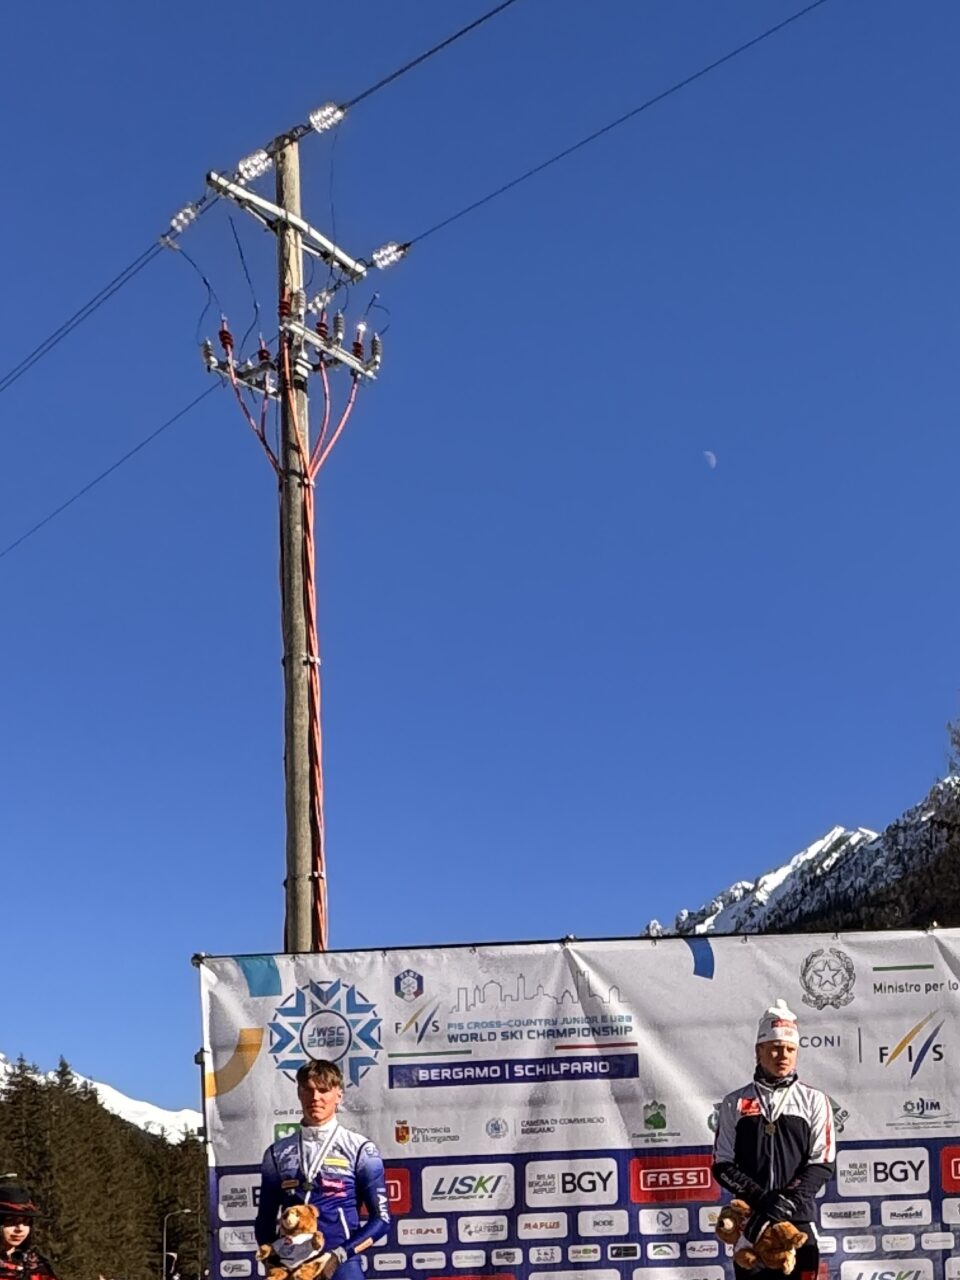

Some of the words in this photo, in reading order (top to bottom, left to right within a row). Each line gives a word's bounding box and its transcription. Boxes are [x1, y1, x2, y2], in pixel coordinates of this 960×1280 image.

[873, 982, 921, 995] Ministro
[925, 983, 943, 995] per
[947, 981, 959, 992] lo
[307, 1026, 345, 1038] JWSC
[447, 1022, 465, 1032] FIS
[466, 1018, 558, 1031] CROSS-COUNTRY
[447, 1031, 497, 1043] WORLD
[501, 1029, 523, 1041] SKI
[527, 1025, 633, 1040] CHAMPIONSHIP
[799, 1034, 841, 1048] CONI
[306, 1036, 345, 1048] 2025
[419, 1066, 500, 1081] BERGAMO
[514, 1061, 610, 1077] SCHILPARIO
[873, 1160, 925, 1182] BGY
[432, 1175, 502, 1195] LISKI
[561, 1171, 614, 1194] BGY
[646, 1172, 704, 1187] FASSI
[222, 1231, 256, 1243] PINET
